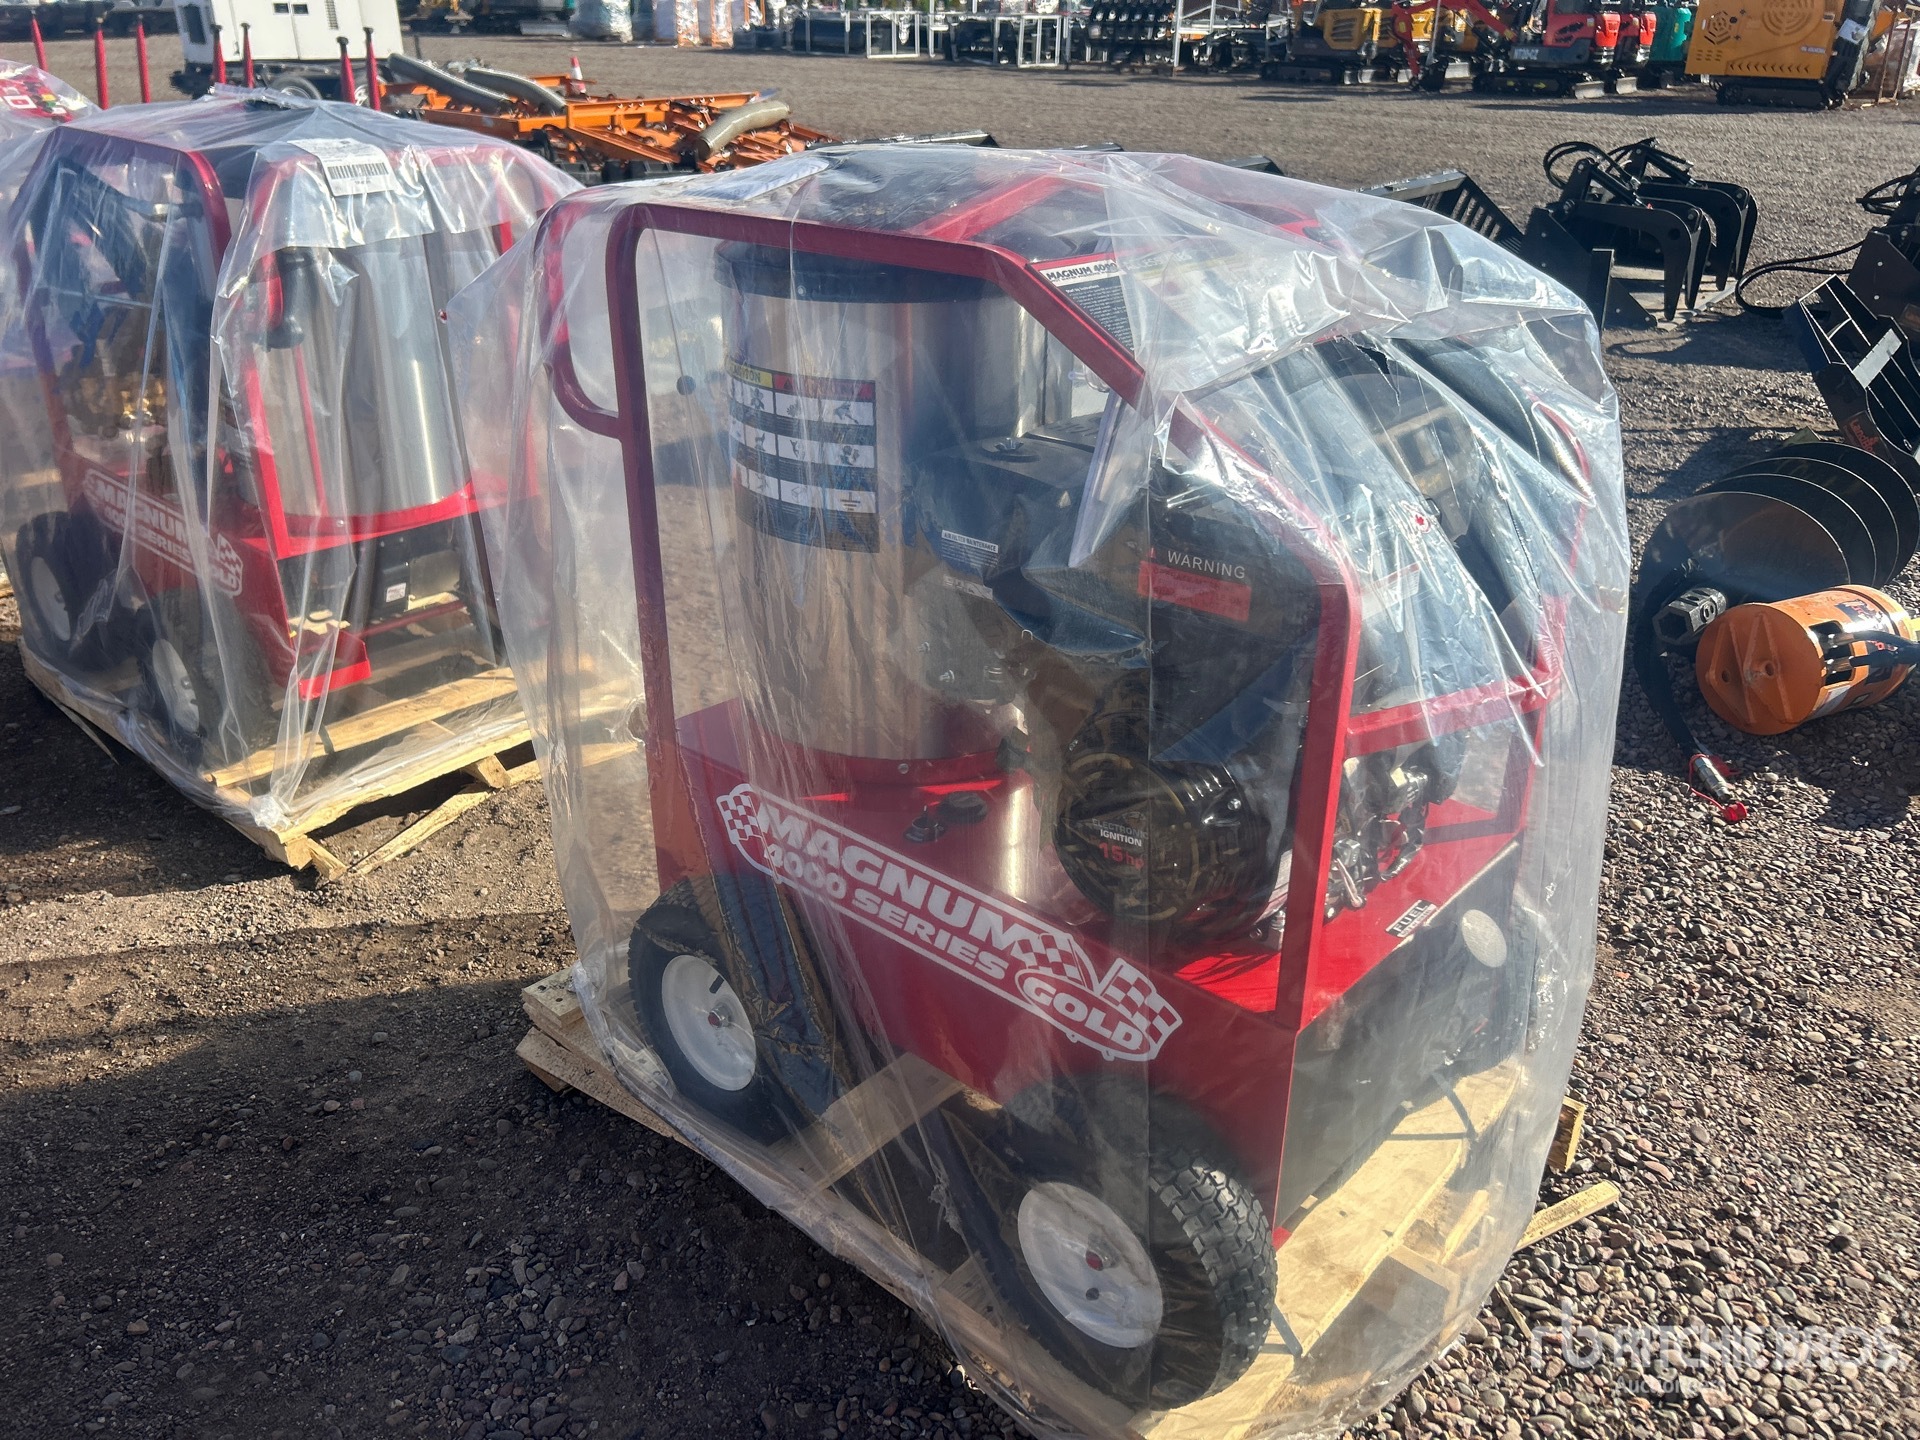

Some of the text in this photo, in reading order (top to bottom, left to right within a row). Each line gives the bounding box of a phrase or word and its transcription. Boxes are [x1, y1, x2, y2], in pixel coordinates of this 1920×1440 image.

[1046, 266, 1092, 281] MAGNUM
[1167, 550, 1246, 579] WARNING
[1091, 817, 1149, 840] ELECTRONIC
[1100, 828, 1142, 847] IGNITION
[757, 802, 1042, 951] MAGNUM
[763, 843, 1010, 980] 4000 SERIES
[1392, 905, 1429, 932] FUEL
[1022, 976, 1144, 1051] GOLD
